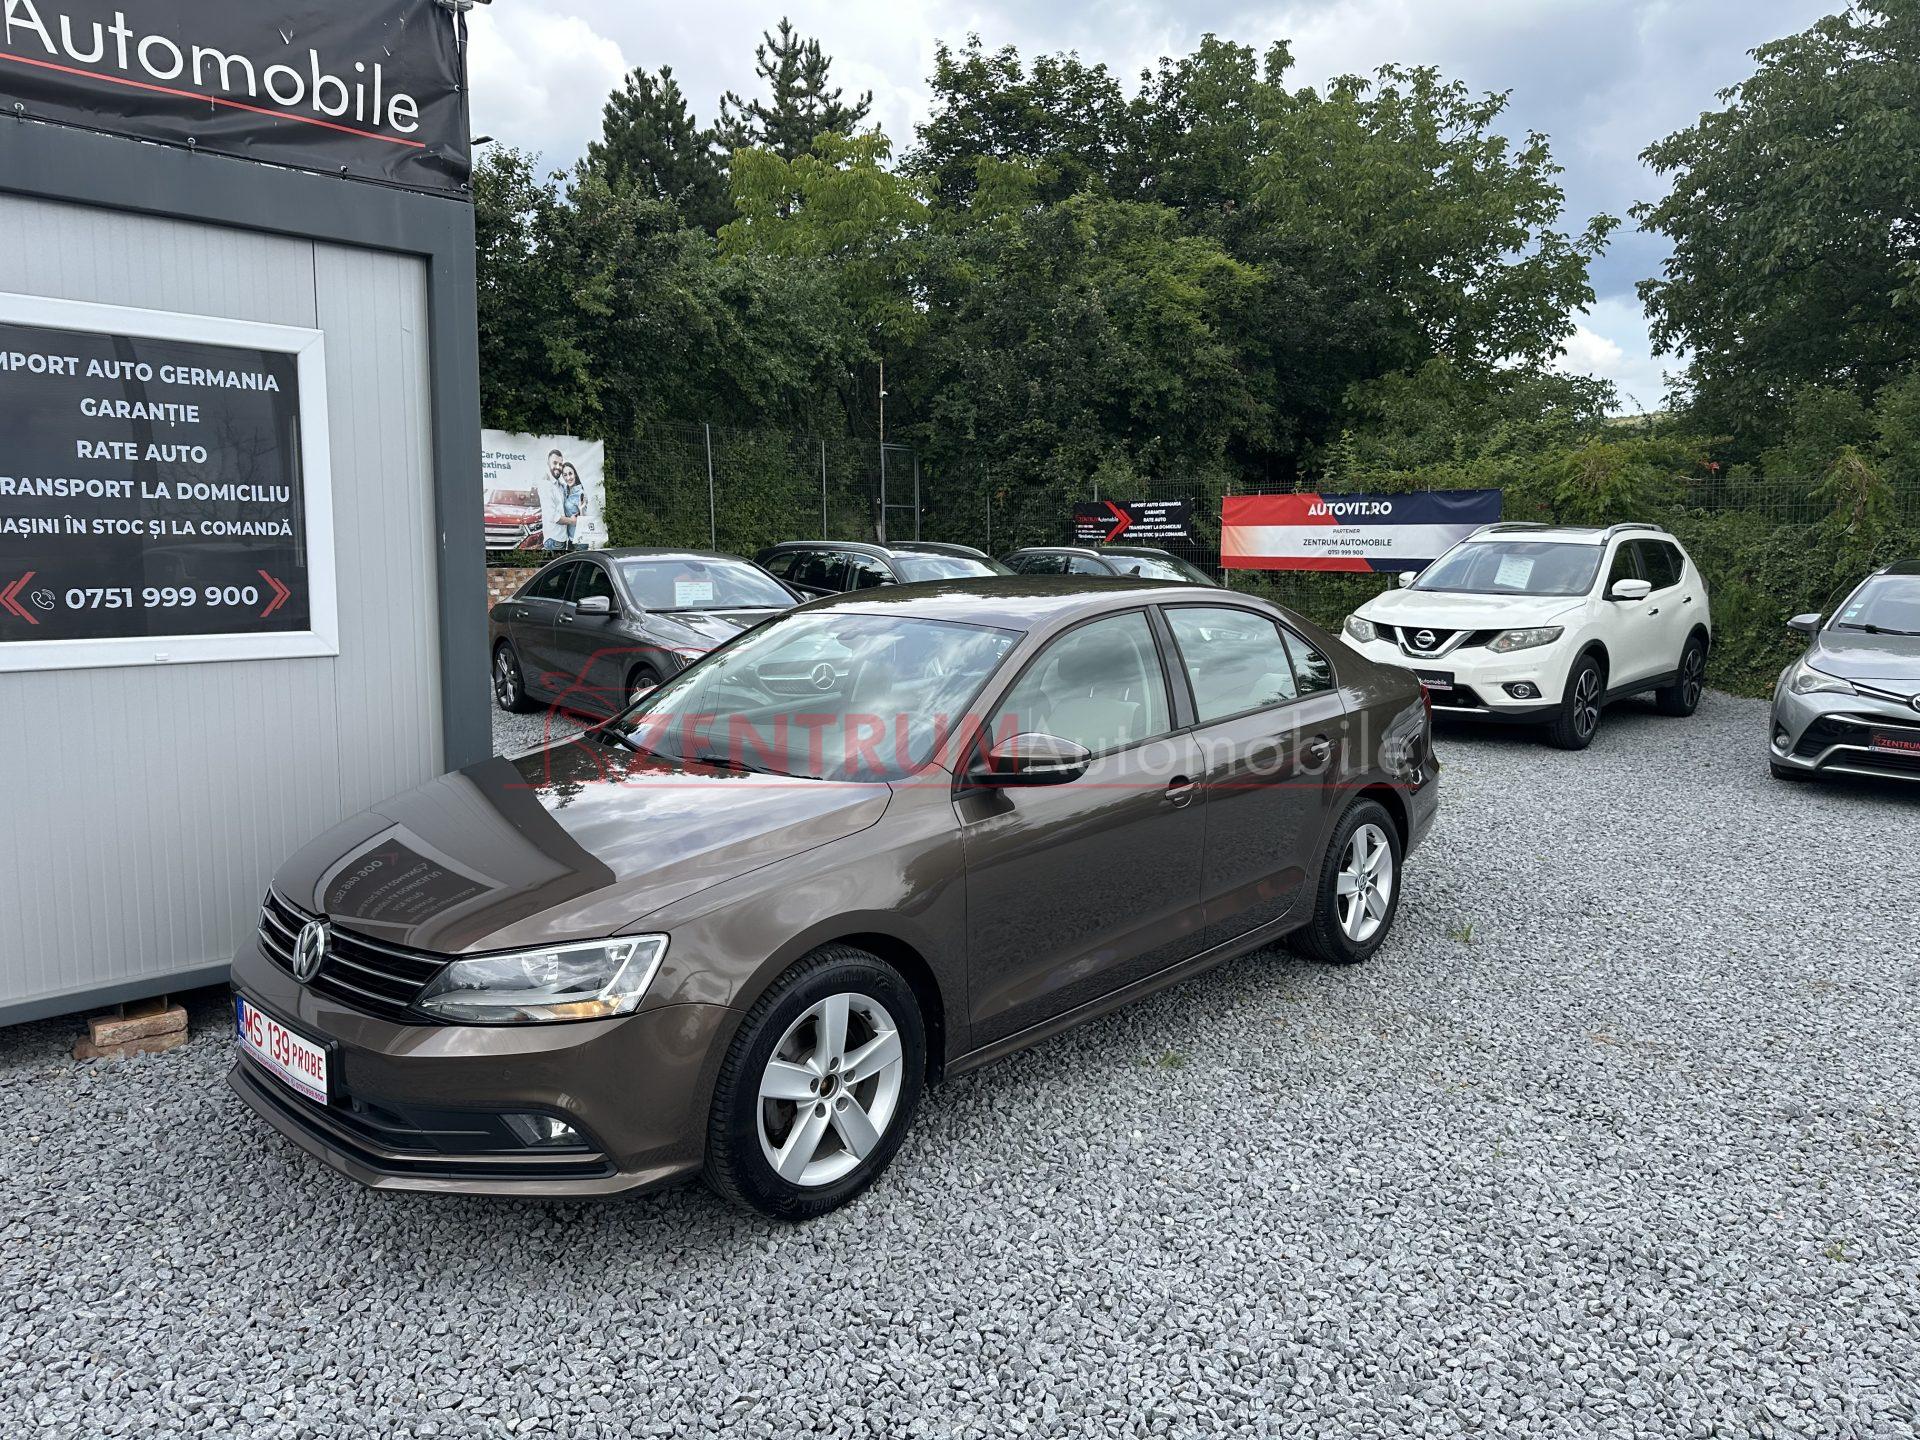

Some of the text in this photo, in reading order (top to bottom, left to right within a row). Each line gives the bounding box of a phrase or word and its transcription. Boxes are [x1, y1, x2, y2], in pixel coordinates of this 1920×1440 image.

[3, 0, 419, 133] Automobile
[86, 361, 153, 383] AUTO
[160, 365, 280, 392] GERMANIA
[79, 397, 200, 427] GARANȚIE
[76, 440, 208, 464] RATE AUTO
[495, 451, 526, 461] Protect
[484, 471, 497, 479] ani
[0, 477, 290, 503] RANSPORT LA DOMICILIU
[1308, 501, 1393, 516] AUTOVIT.RO
[0, 515, 293, 540] AȘINI ÎN STOC ȘI LA COMANDĂ
[1303, 538, 1393, 547] ZENTRUM AUTOMOBILE
[65, 585, 259, 609] 0751 999 900
[244, 1004, 324, 1081] MS 139 PROBE
